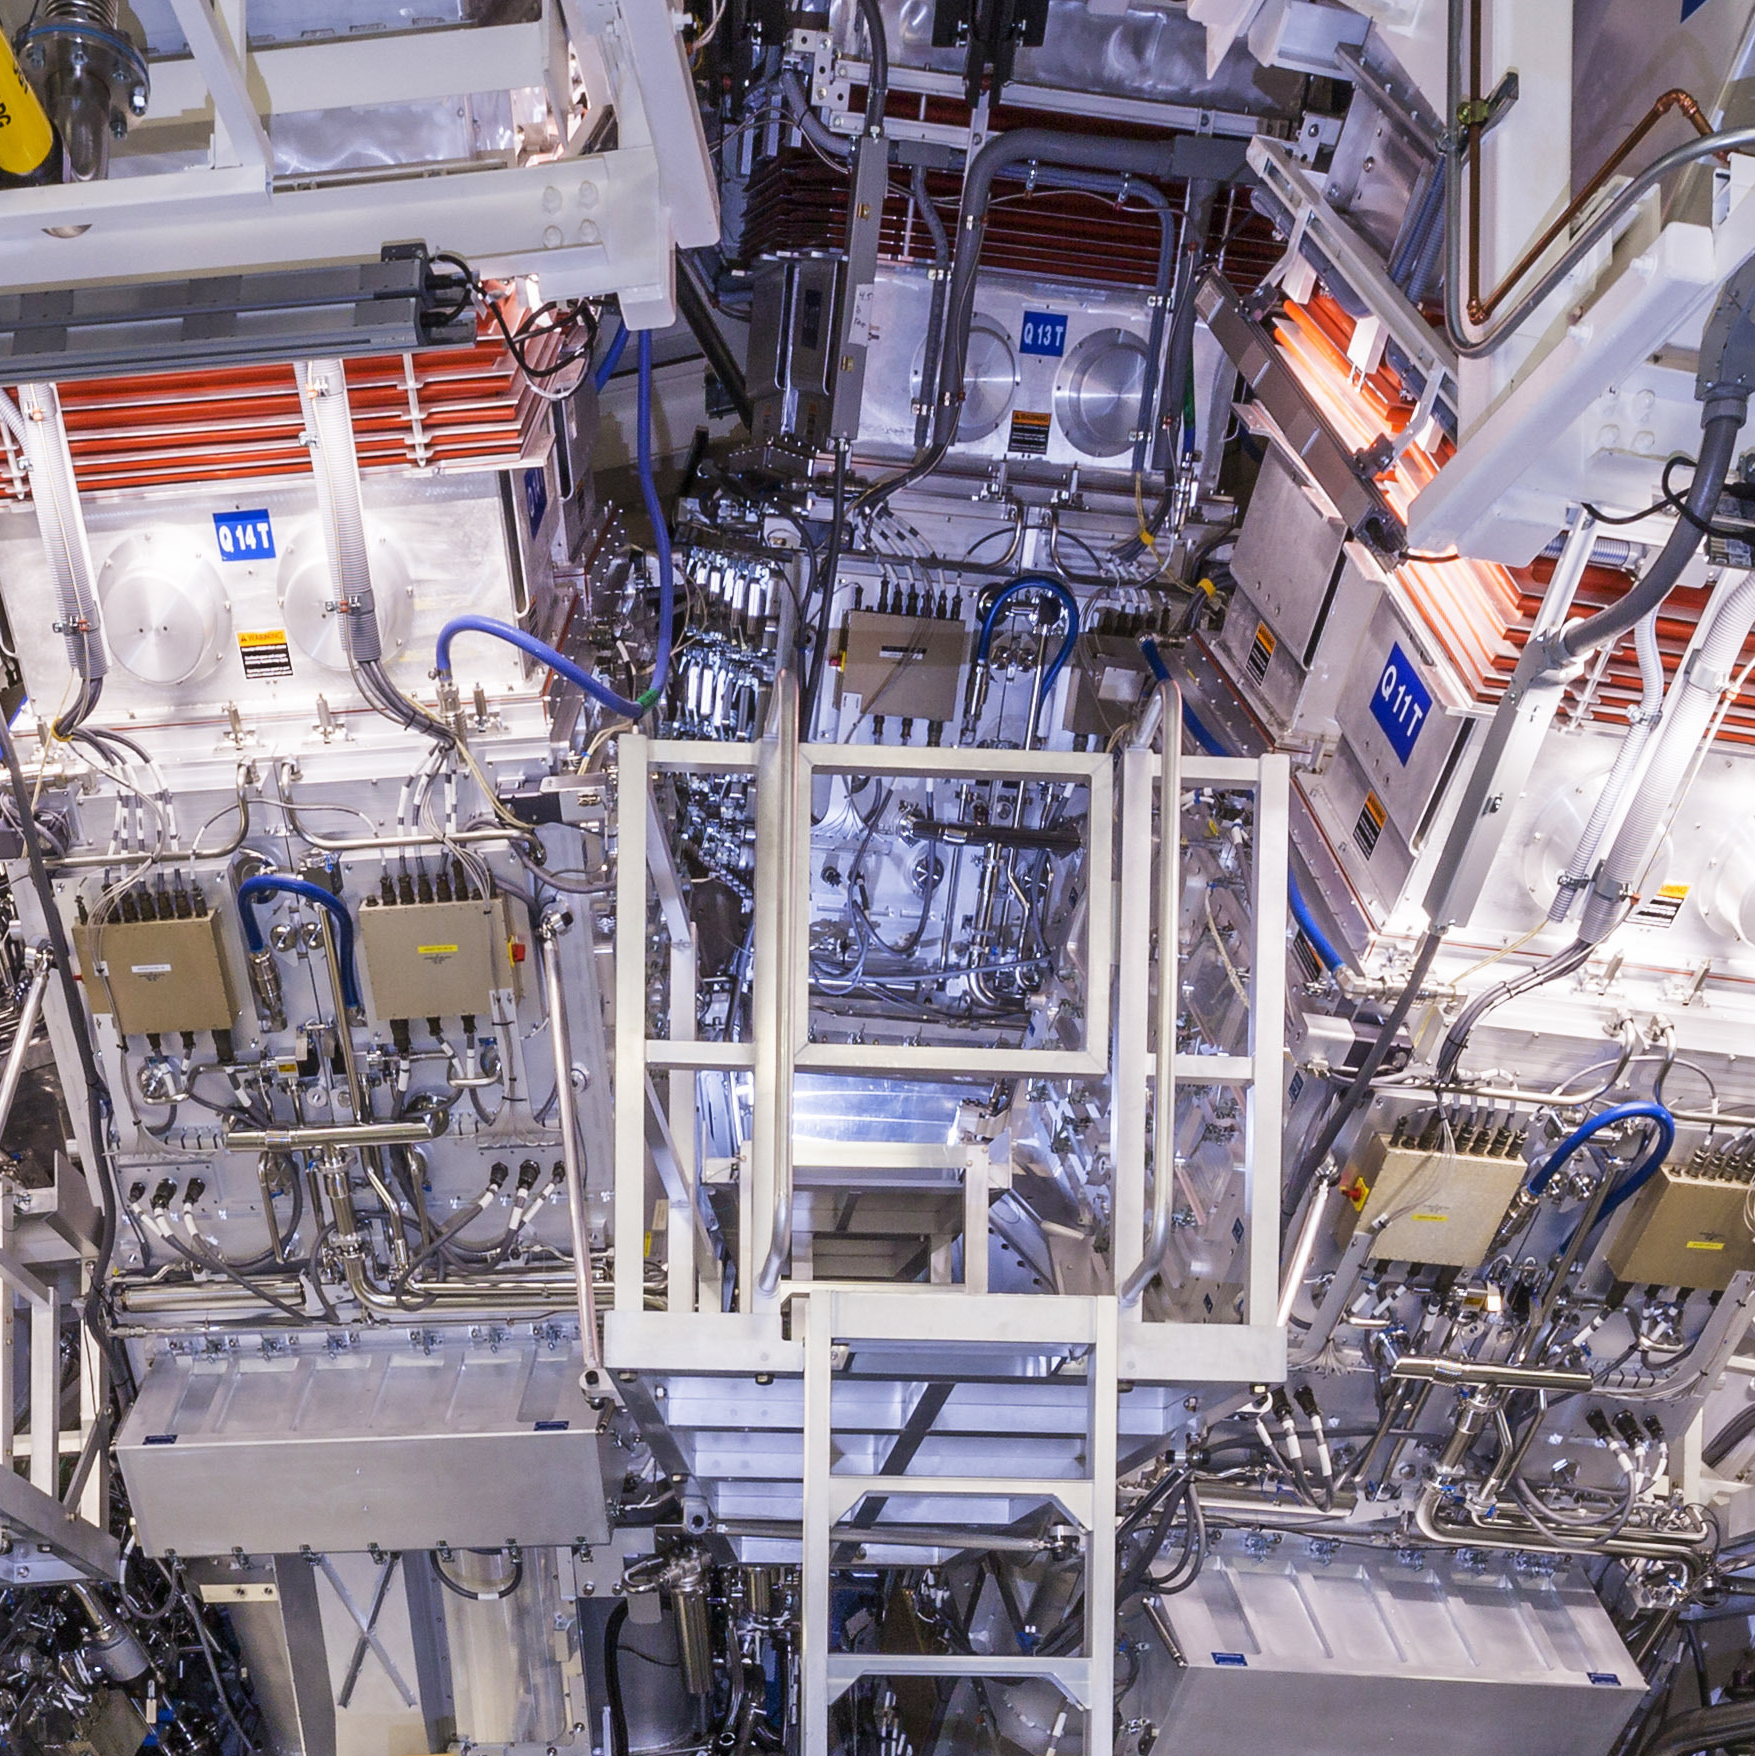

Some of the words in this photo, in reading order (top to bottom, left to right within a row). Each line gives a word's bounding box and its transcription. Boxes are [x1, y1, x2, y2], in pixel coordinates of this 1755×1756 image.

[1023, 323, 1033, 346] Q
[1037, 324, 1052, 347] 13
[1054, 325, 1064, 348] T
[218, 524, 234, 553] Q
[235, 524, 257, 551] 14
[256, 522, 270, 549] T
[248, 631, 284, 642] WARNING
[1381, 665, 1397, 702] Q
[1406, 702, 1423, 737] T
